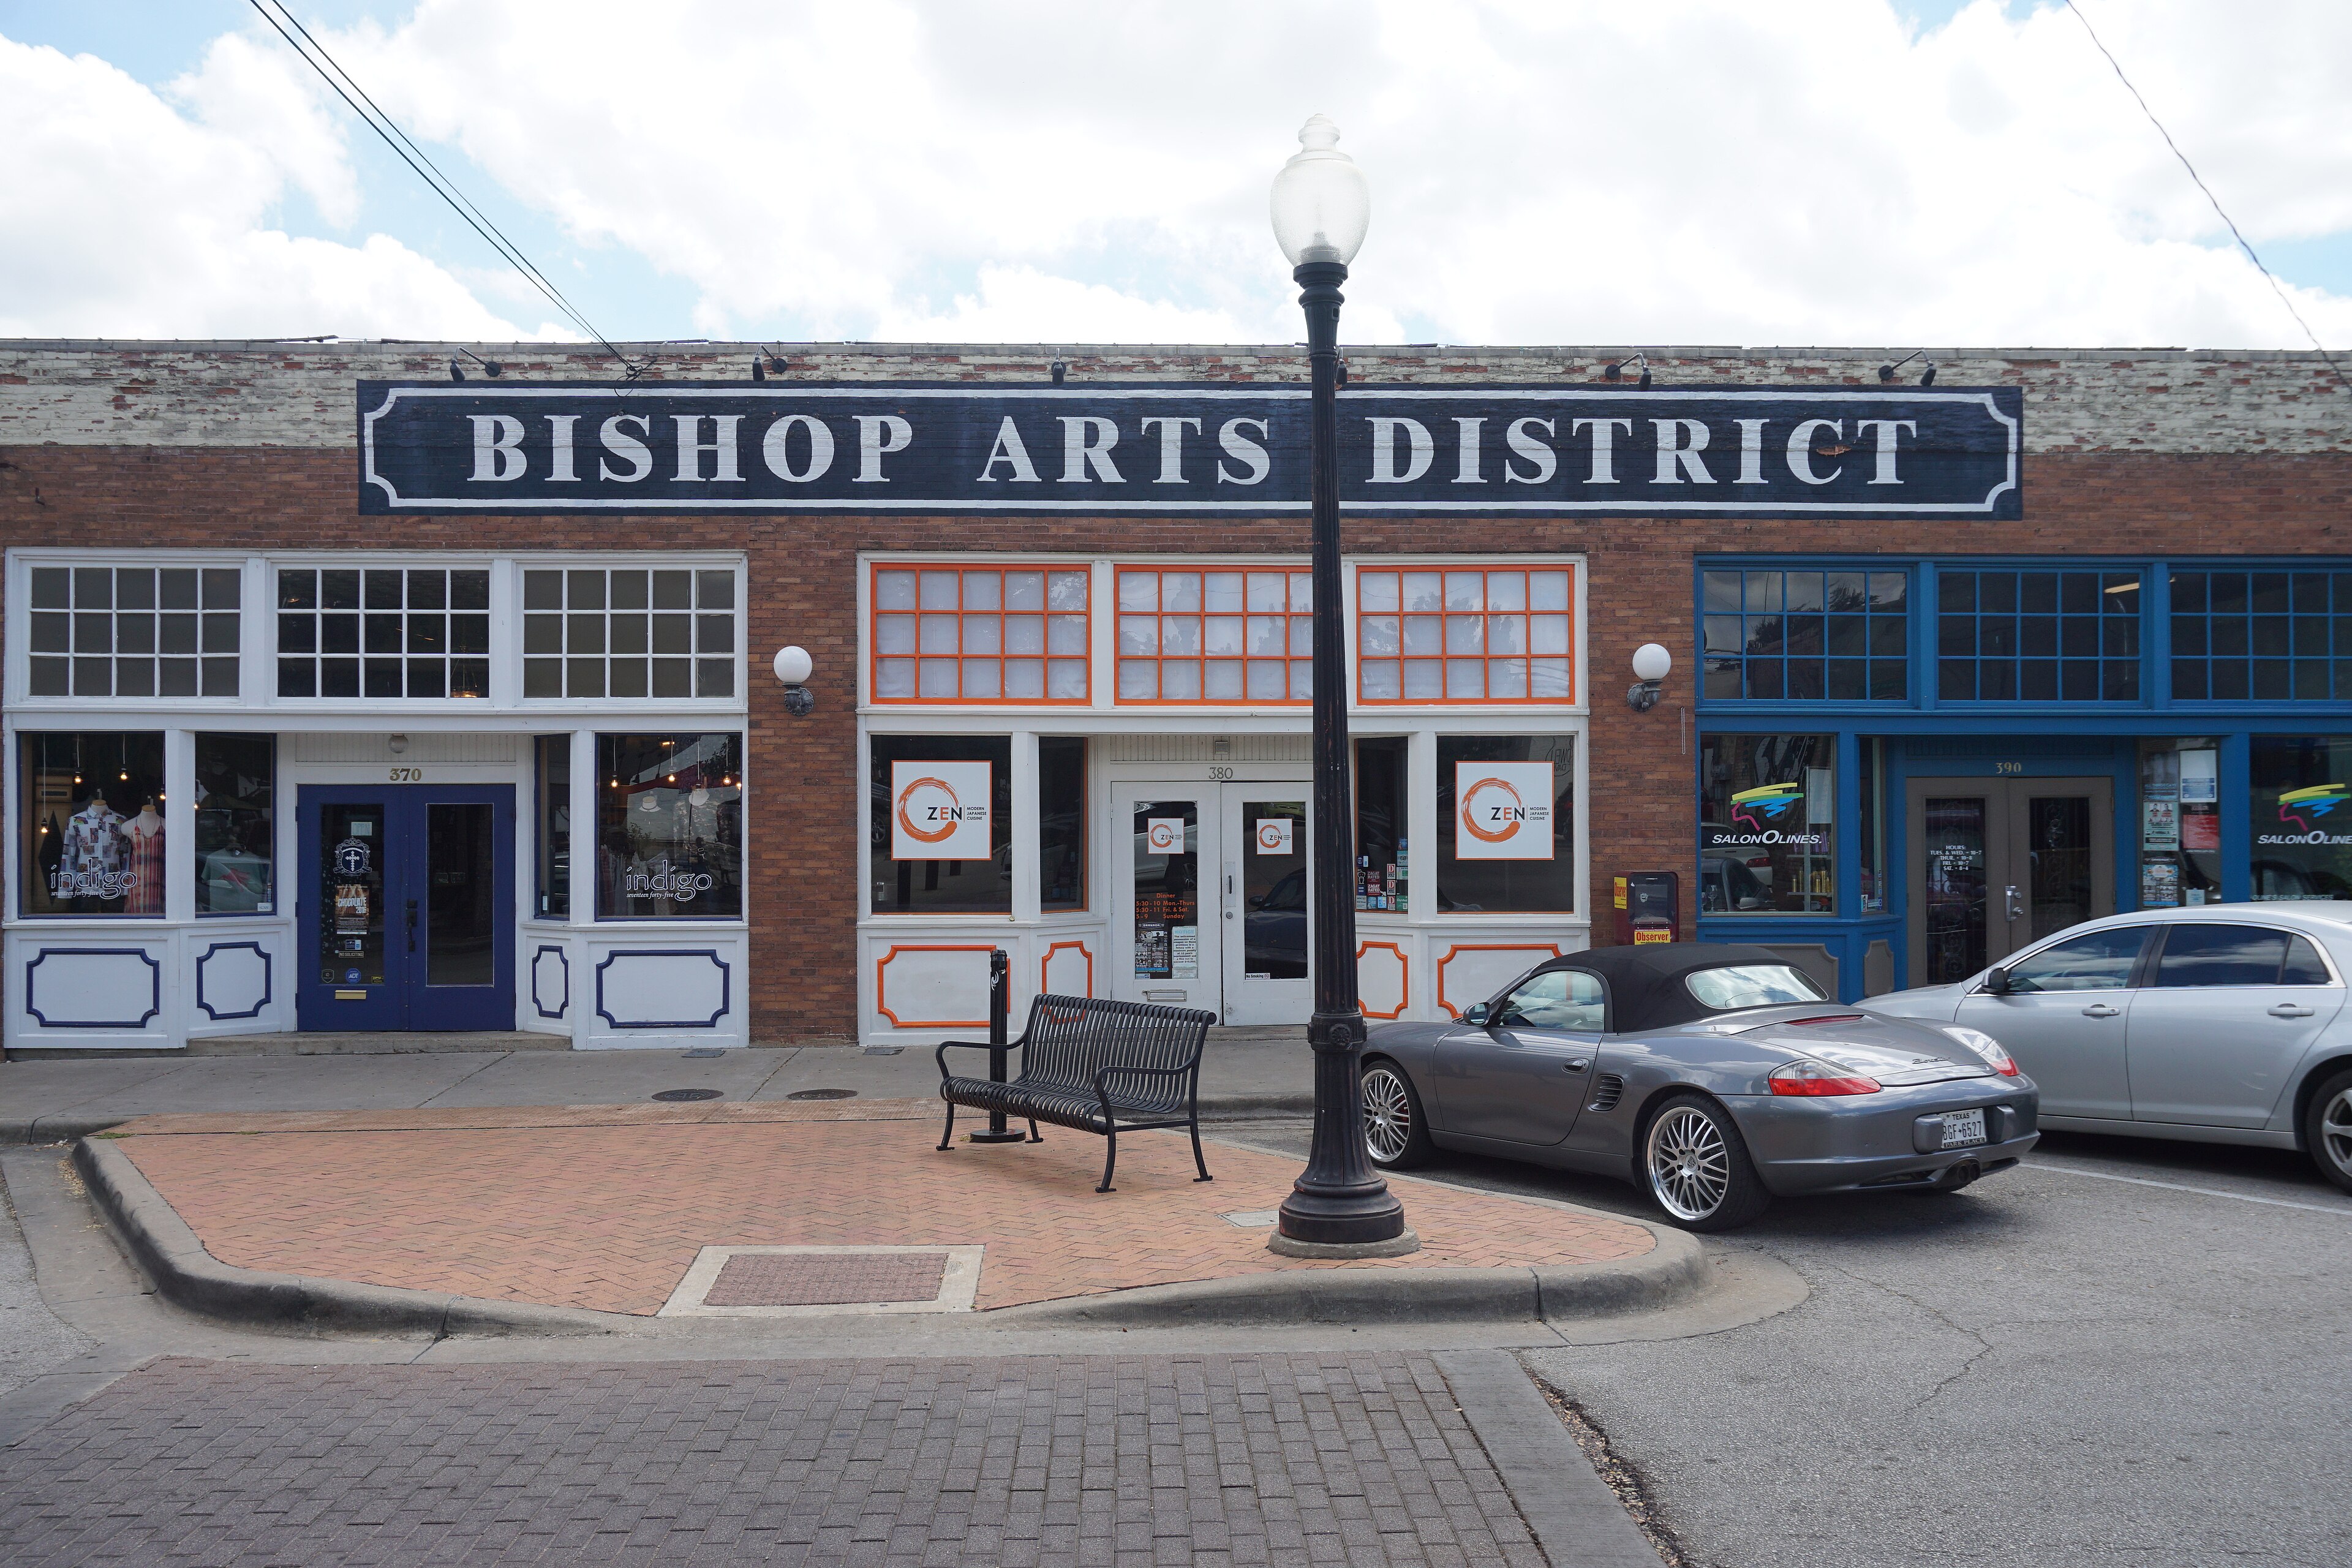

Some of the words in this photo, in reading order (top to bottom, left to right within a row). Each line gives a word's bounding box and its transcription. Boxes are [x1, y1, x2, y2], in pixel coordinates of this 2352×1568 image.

[467, 414, 913, 483] BISHOP
[976, 416, 1270, 484] ARTS
[1365, 417, 1917, 485] DISTRICT
[390, 768, 422, 781] 370
[1208, 767, 1233, 779] 380
[1996, 762, 2021, 774] 390
[927, 807, 962, 820] ZEN
[1491, 807, 1525, 820] ZEN
[51, 858, 137, 899] indigo
[627, 859, 712, 902] indigo
[1636, 932, 1668, 941] Observer
